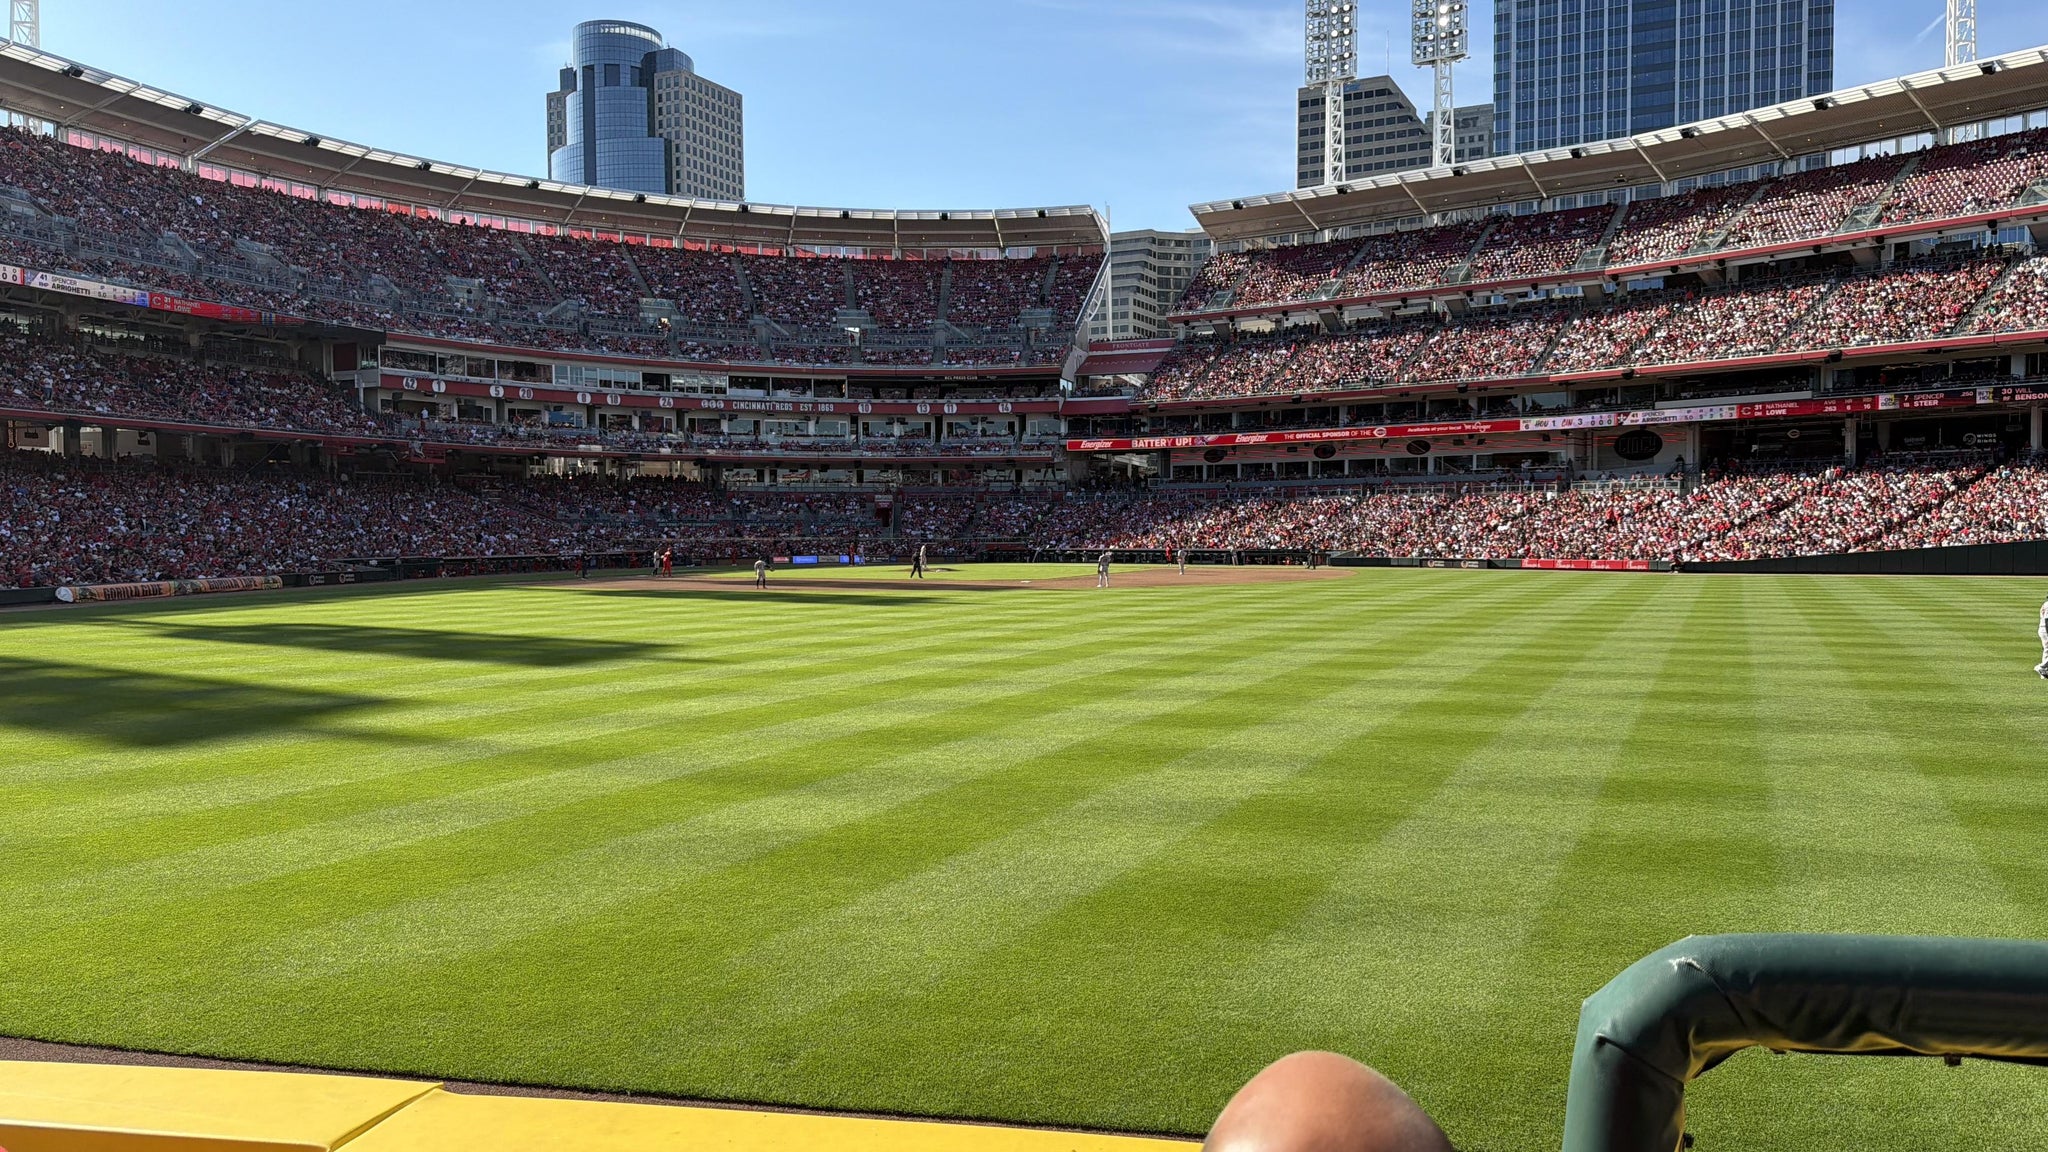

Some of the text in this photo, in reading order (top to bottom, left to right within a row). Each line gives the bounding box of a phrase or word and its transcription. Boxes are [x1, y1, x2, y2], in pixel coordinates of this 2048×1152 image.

[2, 272, 8, 280] 0
[51, 282, 91, 296] ARRIGHETTI
[174, 306, 192, 314] LOWE
[404, 380, 416, 390] 42
[436, 380, 442, 392] 1
[494, 386, 500, 396] 5
[520, 388, 532, 398] 20
[2015, 393, 2048, 401] BENSON
[661, 398, 673, 408] 24
[732, 401, 834, 412] CINCINNATI REDS EST. 1869
[1001, 404, 1010, 412] 14
[918, 404, 928, 413] 13
[946, 404, 955, 413] 11
[1534, 419, 1549, 427] HOU
[1561, 418, 1574, 427] CIN
[1235, 433, 1269, 444] Energizer
[1322, 430, 1350, 438] SPONSOR
[1080, 437, 1192, 450] Energizer BATTERY UP!
[103, 584, 164, 600] GORILLA GLUE
